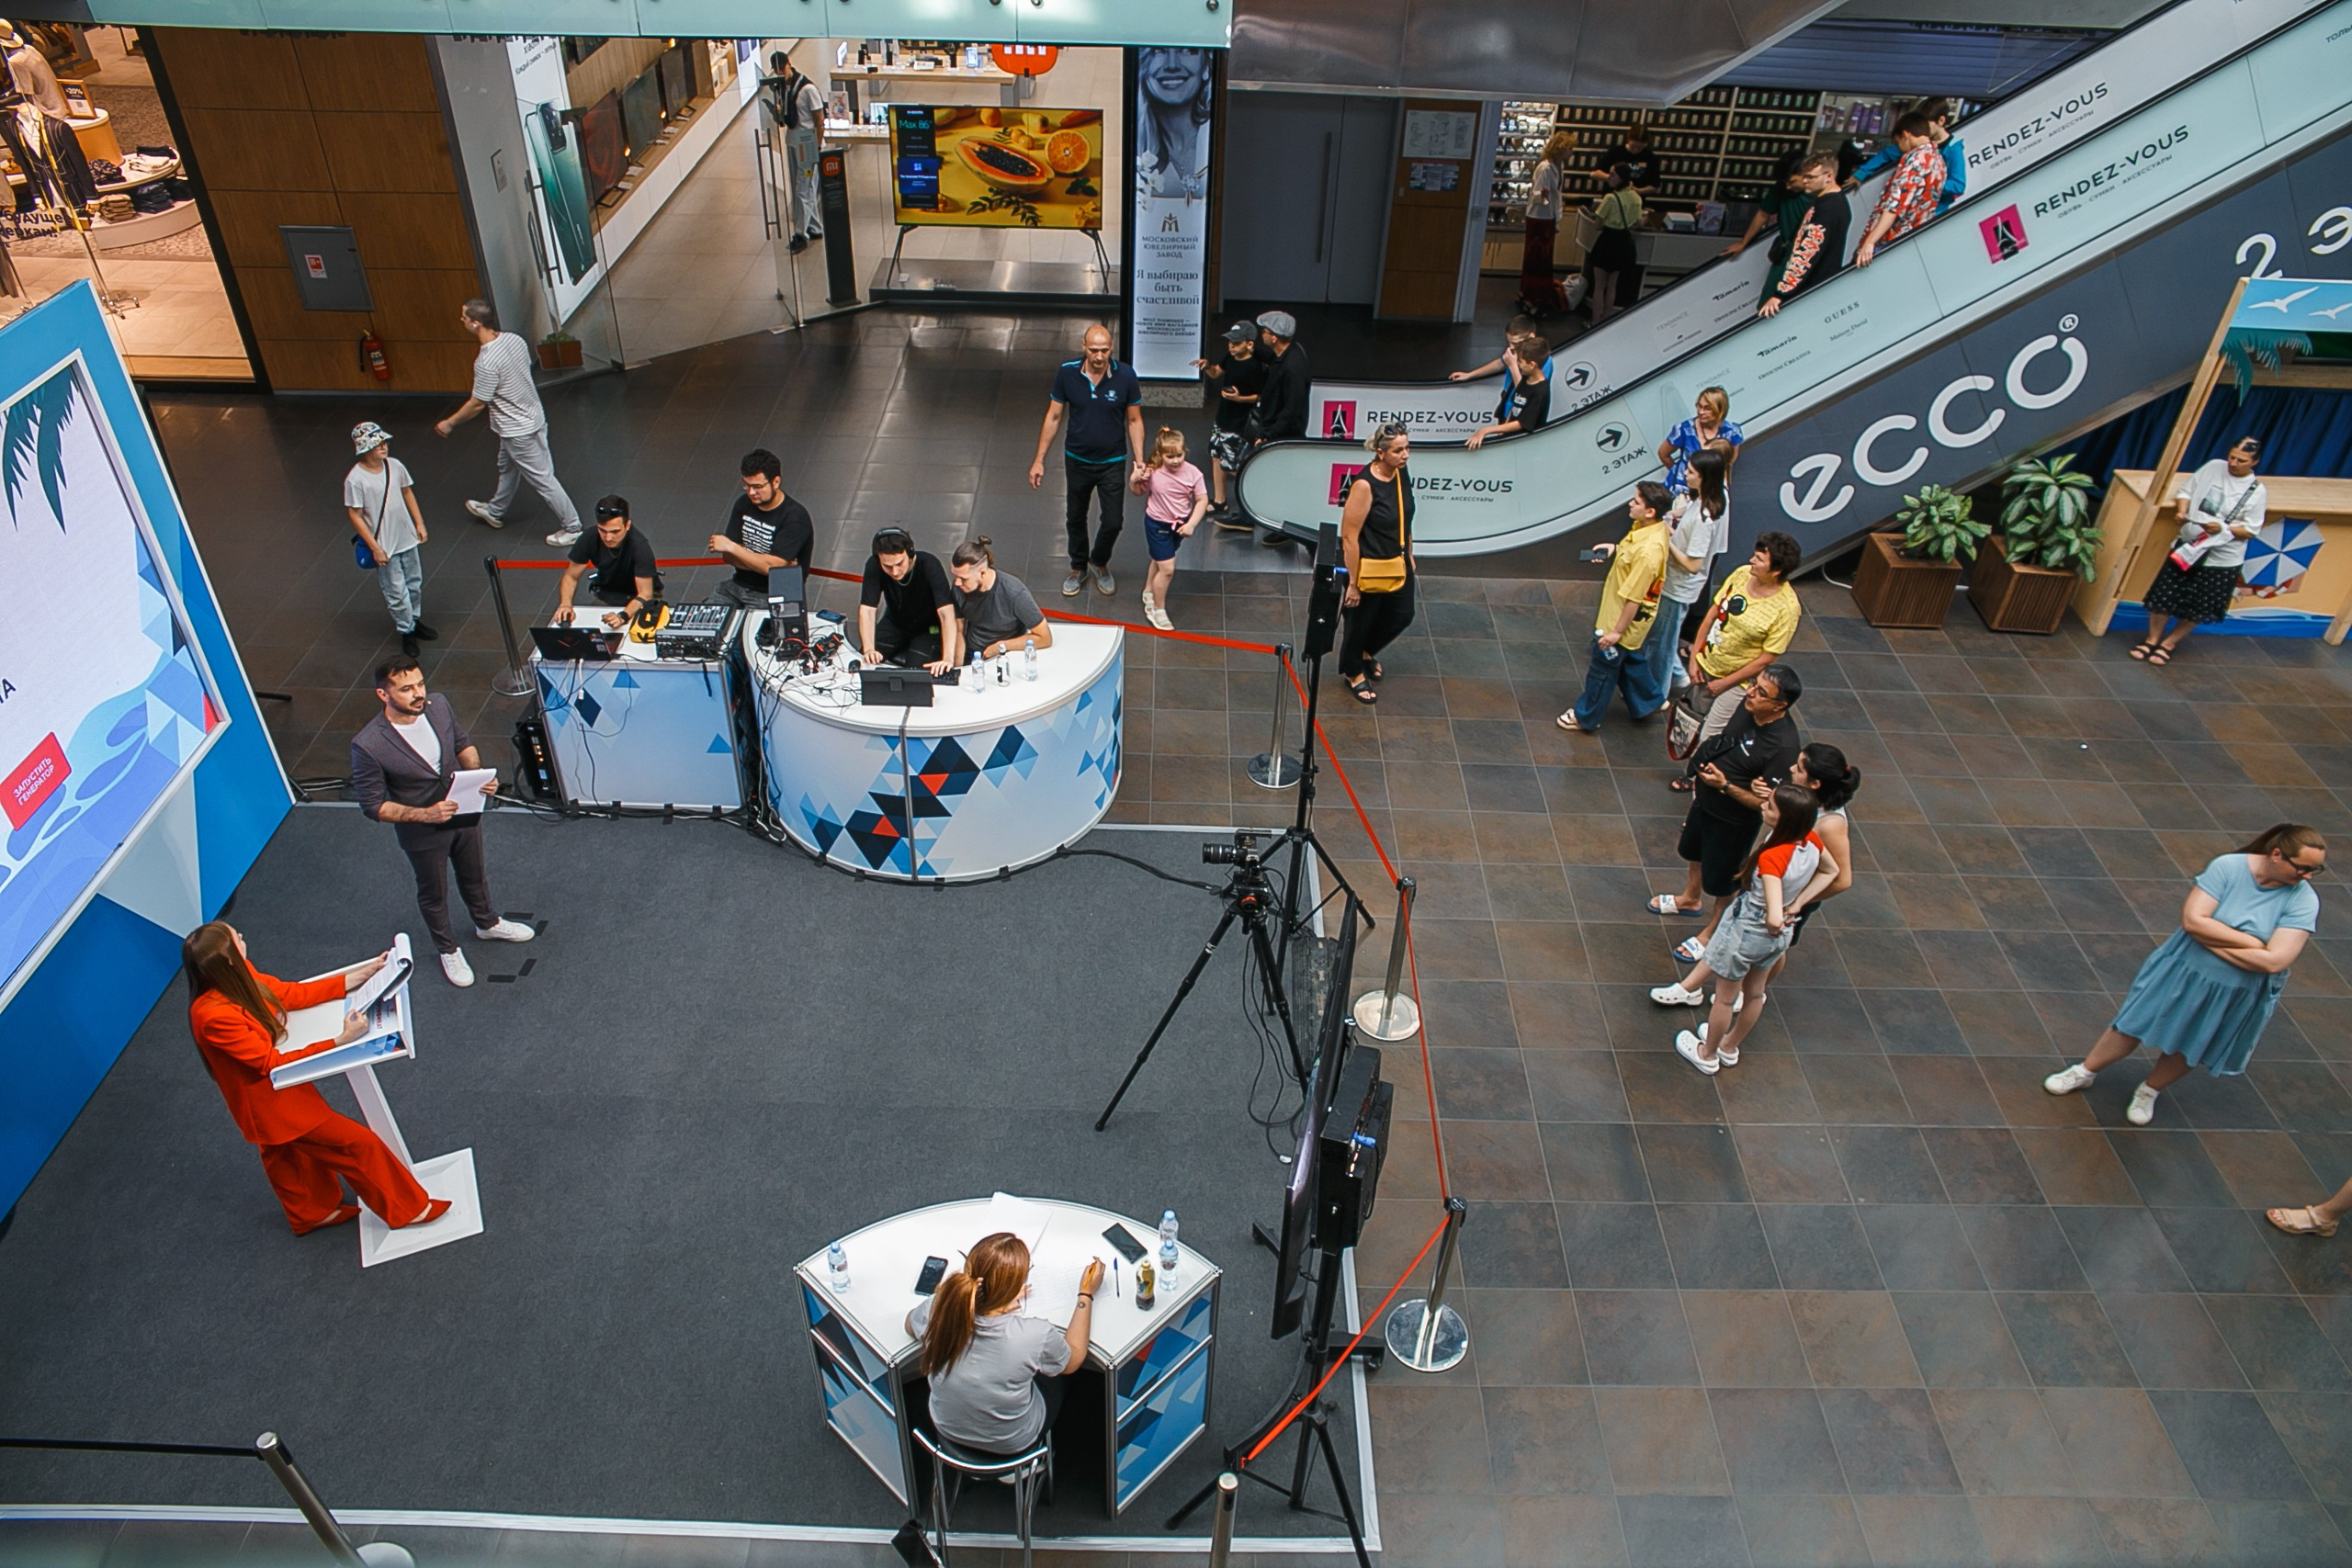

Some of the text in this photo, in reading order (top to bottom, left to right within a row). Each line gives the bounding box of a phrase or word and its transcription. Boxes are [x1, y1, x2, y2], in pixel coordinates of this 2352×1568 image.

[1968, 82, 2109, 169] RENDEZ-VOUS
[2049, 109, 2095, 138] АКСЕССУАРЫ
[2034, 125, 2189, 219] RENDEZ-VOUS
[2057, 154, 2174, 220] ОБУВЬ СУМКИ АКСЕССУАРЫ
[1142, 234, 1199, 243] МОСКОВСКИЙ
[1144, 243, 1196, 251] ЮВЕЛИРНЫЙ
[2235, 232, 2283, 279] 2
[1136, 269, 1199, 282] Я выбираю
[1154, 282, 1183, 293] быть
[1136, 294, 1200, 305] счастливой
[1824, 300, 1860, 324] GUESS
[1580, 384, 1613, 407] ЭТАЖ
[1367, 412, 1493, 424] RENDEZ-VOUS
[1780, 334, 2088, 523] ecco
[1601, 446, 1647, 475] 2 ЭТАЖ
[1410, 478, 1514, 493] NDEZ-VOUS
[13, 757, 52, 798] ЗАПУСТИТЬ
[17, 764, 55, 807] ГЕНЕРАТОР
